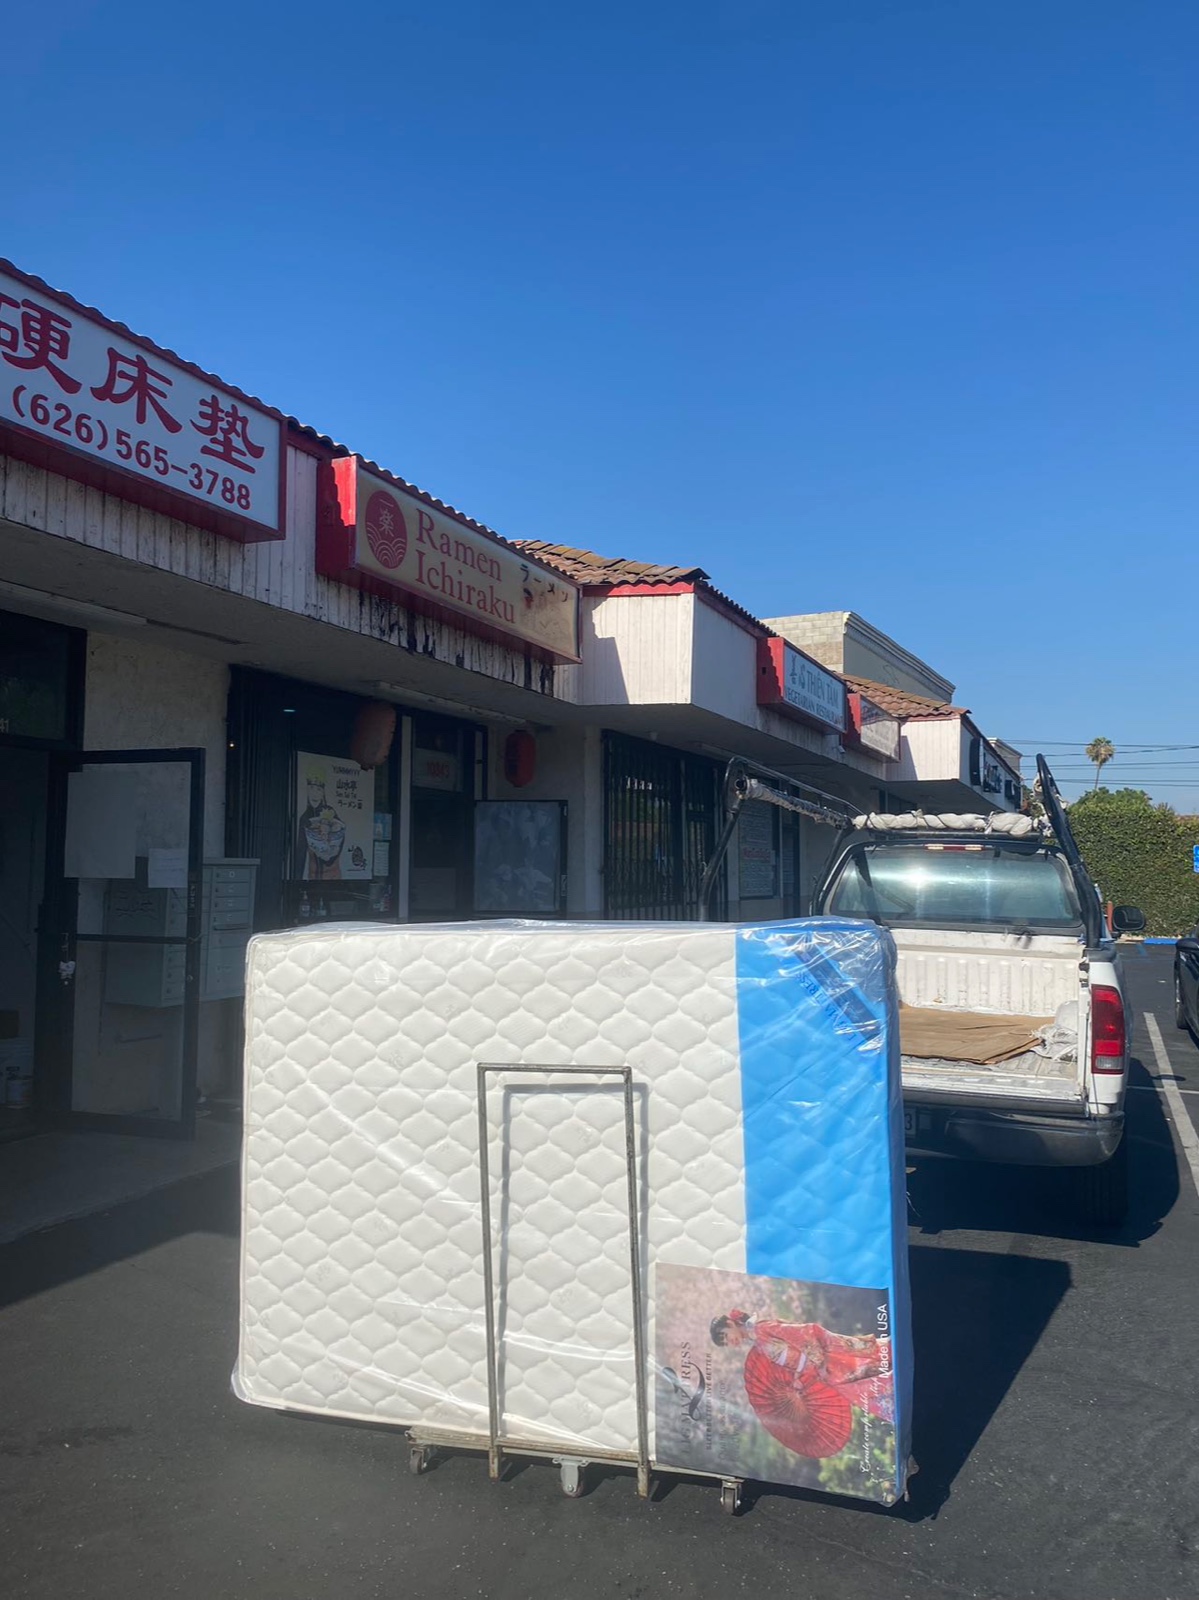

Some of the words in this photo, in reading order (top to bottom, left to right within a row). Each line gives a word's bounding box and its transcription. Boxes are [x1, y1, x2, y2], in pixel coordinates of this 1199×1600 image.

[12, 384, 251, 510] (626)565-3788
[416, 507, 503, 582] Ramen
[415, 549, 516, 624] Ichiraku
[877, 1303, 888, 1331] USA
[879, 1346, 889, 1379] Made
